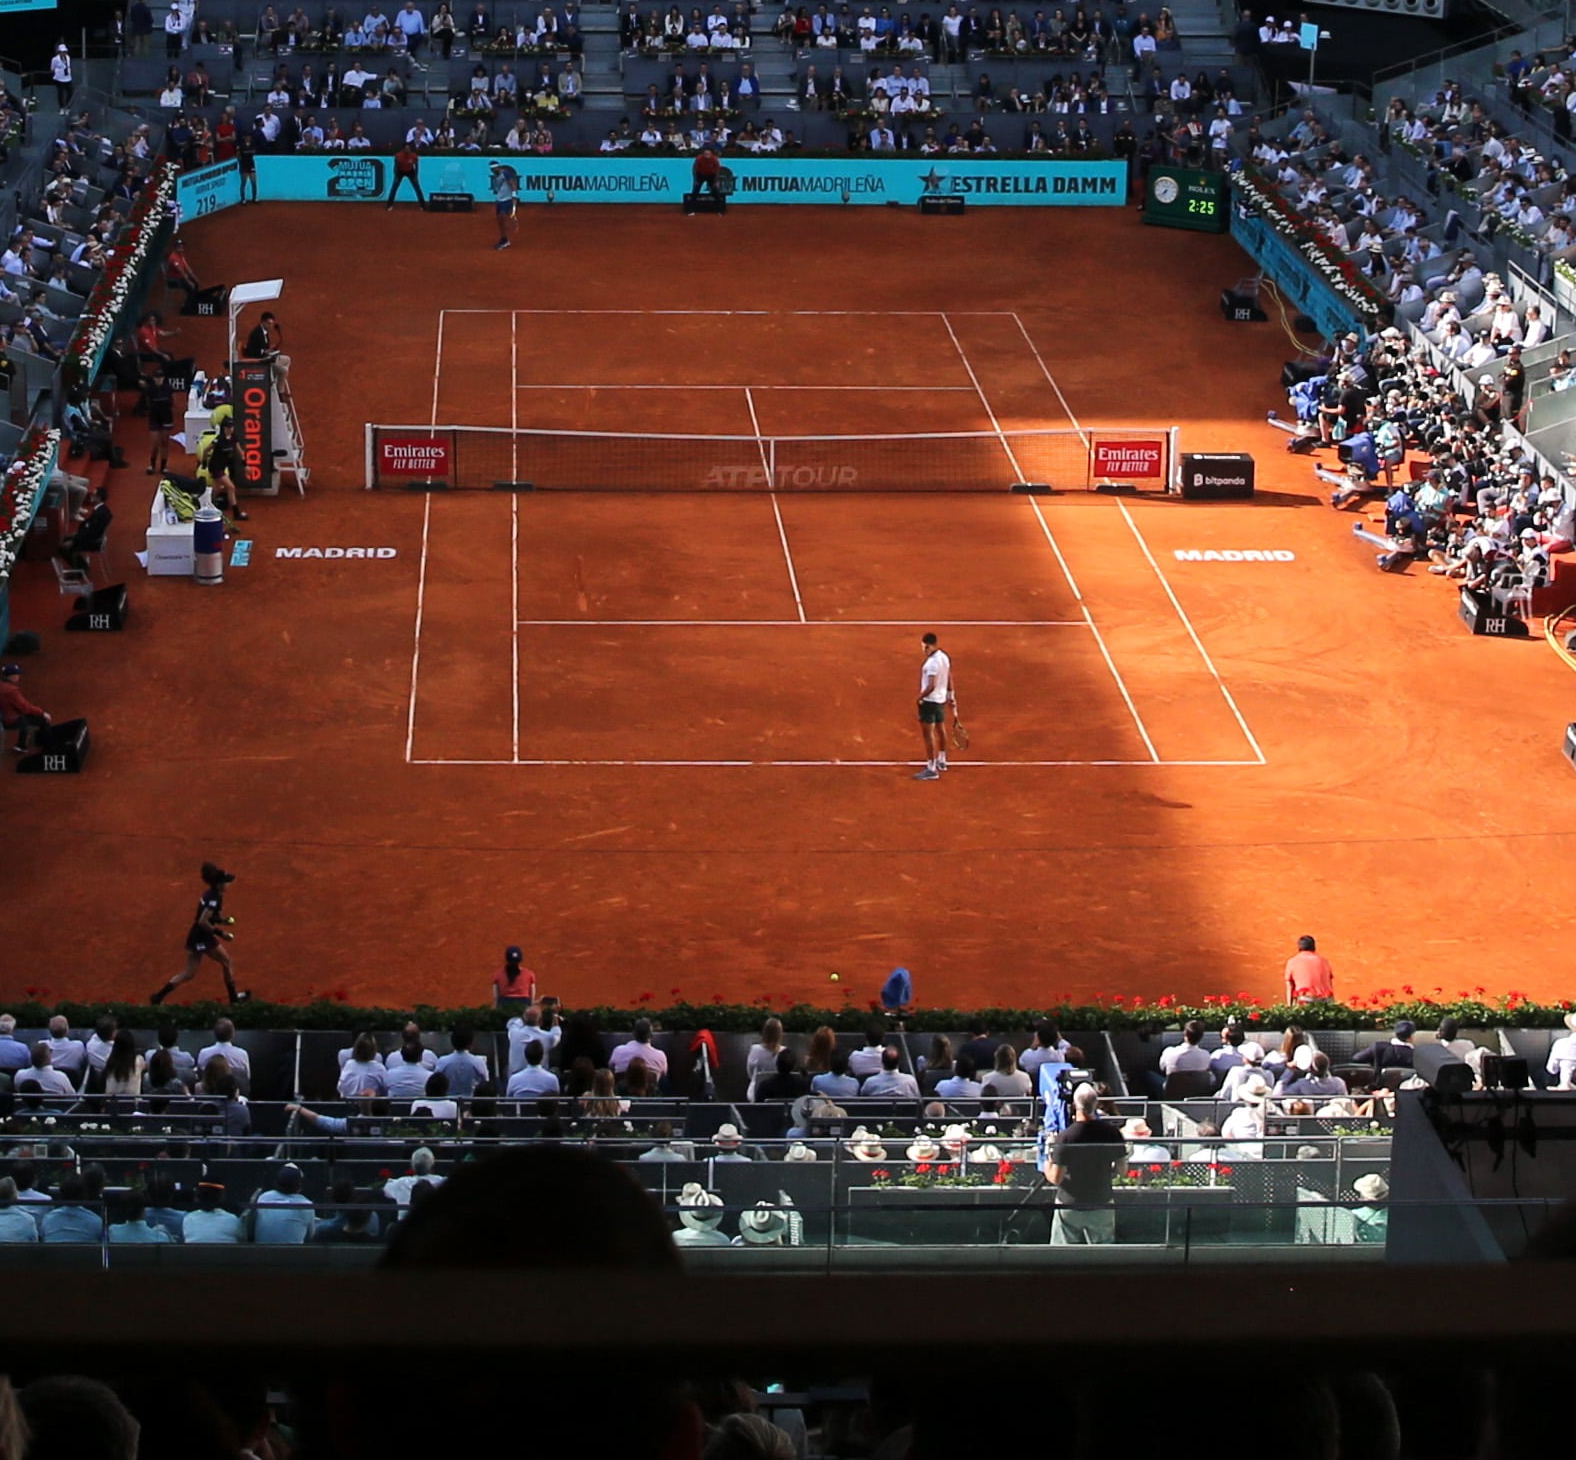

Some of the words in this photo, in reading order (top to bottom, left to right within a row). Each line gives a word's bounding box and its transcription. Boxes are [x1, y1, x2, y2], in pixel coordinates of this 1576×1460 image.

[338, 161, 372, 170] MUTUA
[338, 177, 372, 188] OPEN
[526, 172, 669, 191] MUTUAMADRILEÑA
[742, 174, 885, 193] MUTUAMADRILEÑA
[952, 176, 1047, 194] ESTRELLA
[1052, 176, 1116, 194] DAMM
[196, 194, 216, 216] 219
[1188, 199, 1215, 215] 2:25
[243, 387, 267, 481] Orange
[383, 444, 445, 458] Emirates
[1098, 447, 1159, 461] Emirates
[393, 458, 406, 469] FLY
[408, 458, 437, 469] BETTER
[1106, 461, 1121, 472] FLY
[1121, 461, 1150, 472] BETTER
[772, 465, 858, 488] TOUR
[1205, 475, 1246, 486] bitpanda
[275, 546, 397, 559] MADRID
[1174, 549, 1295, 562] MADRID
